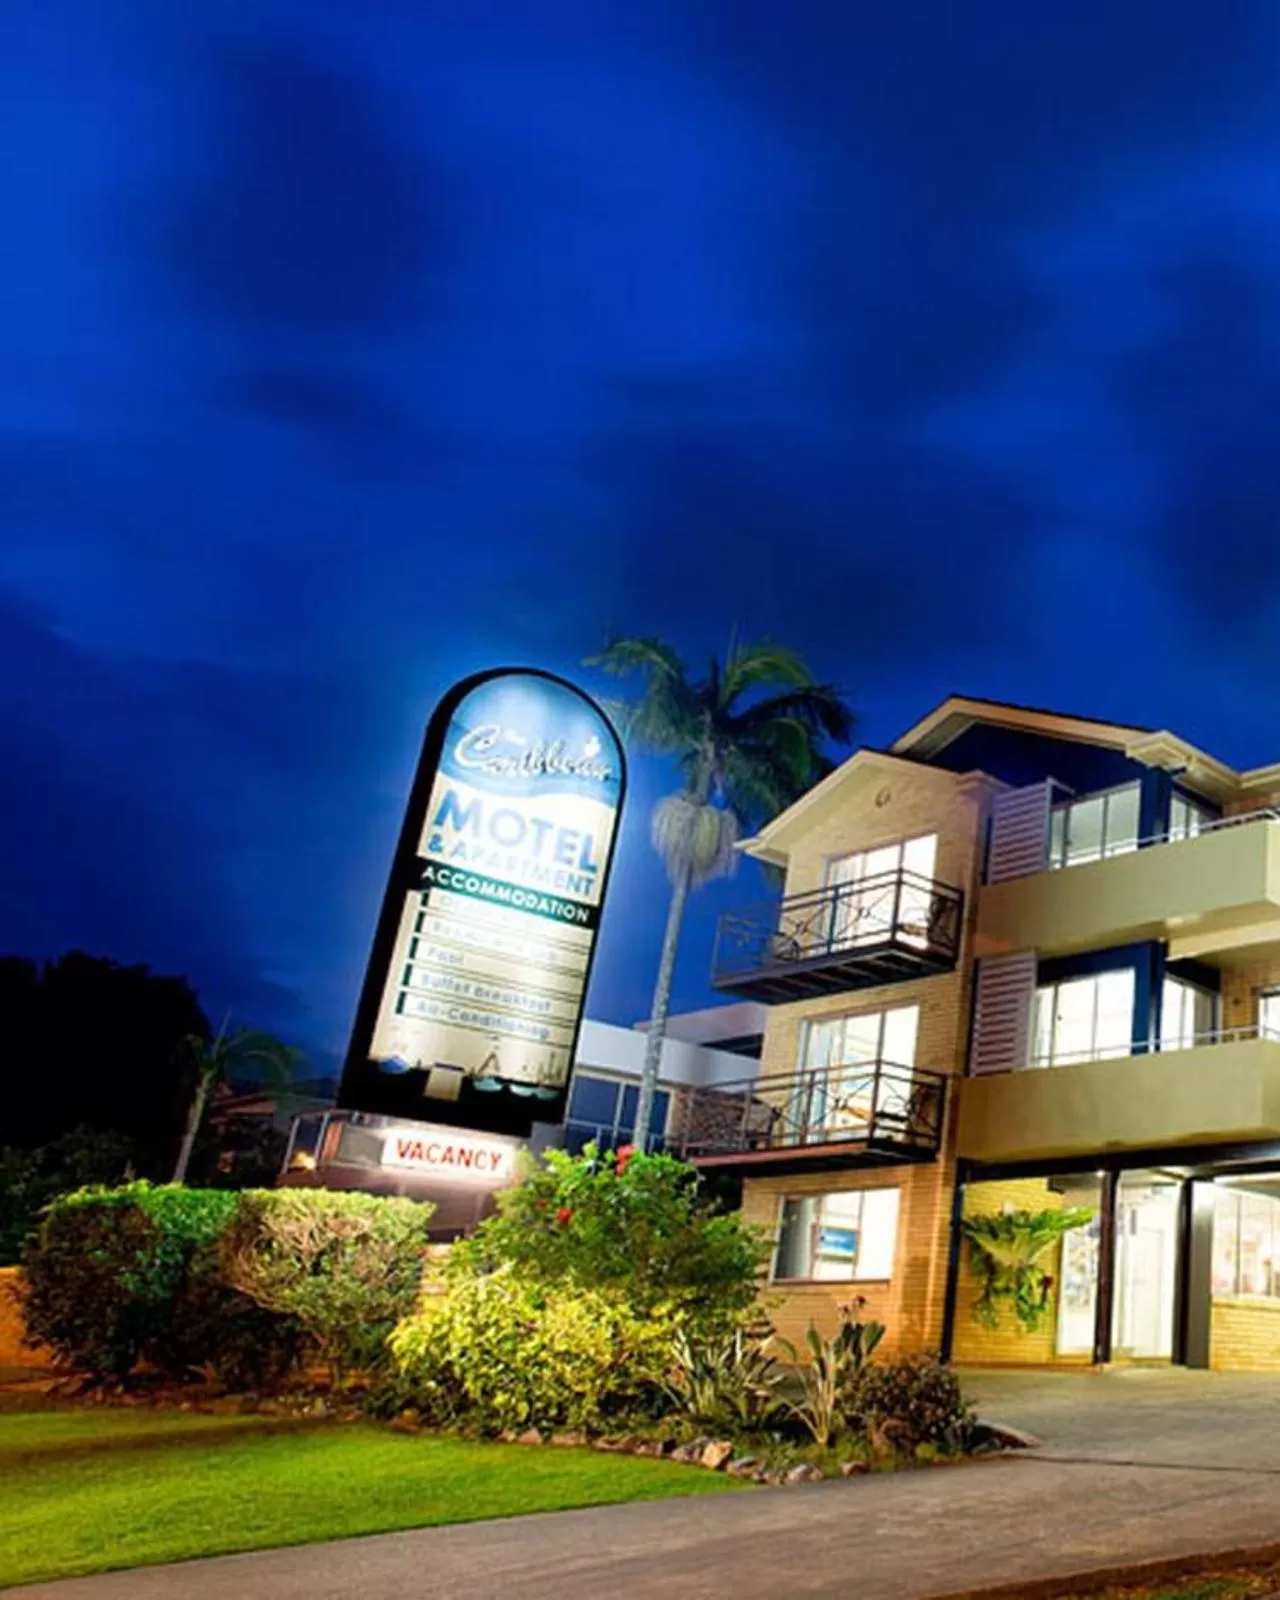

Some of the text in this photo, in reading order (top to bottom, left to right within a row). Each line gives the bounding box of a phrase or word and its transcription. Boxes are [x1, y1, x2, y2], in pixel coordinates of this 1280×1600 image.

[434, 789, 598, 874] MOTEL
[421, 865, 591, 923] ACCOMMODATION
[427, 833, 595, 897] & APARTMENT
[395, 1138, 503, 1172] VACANCY
